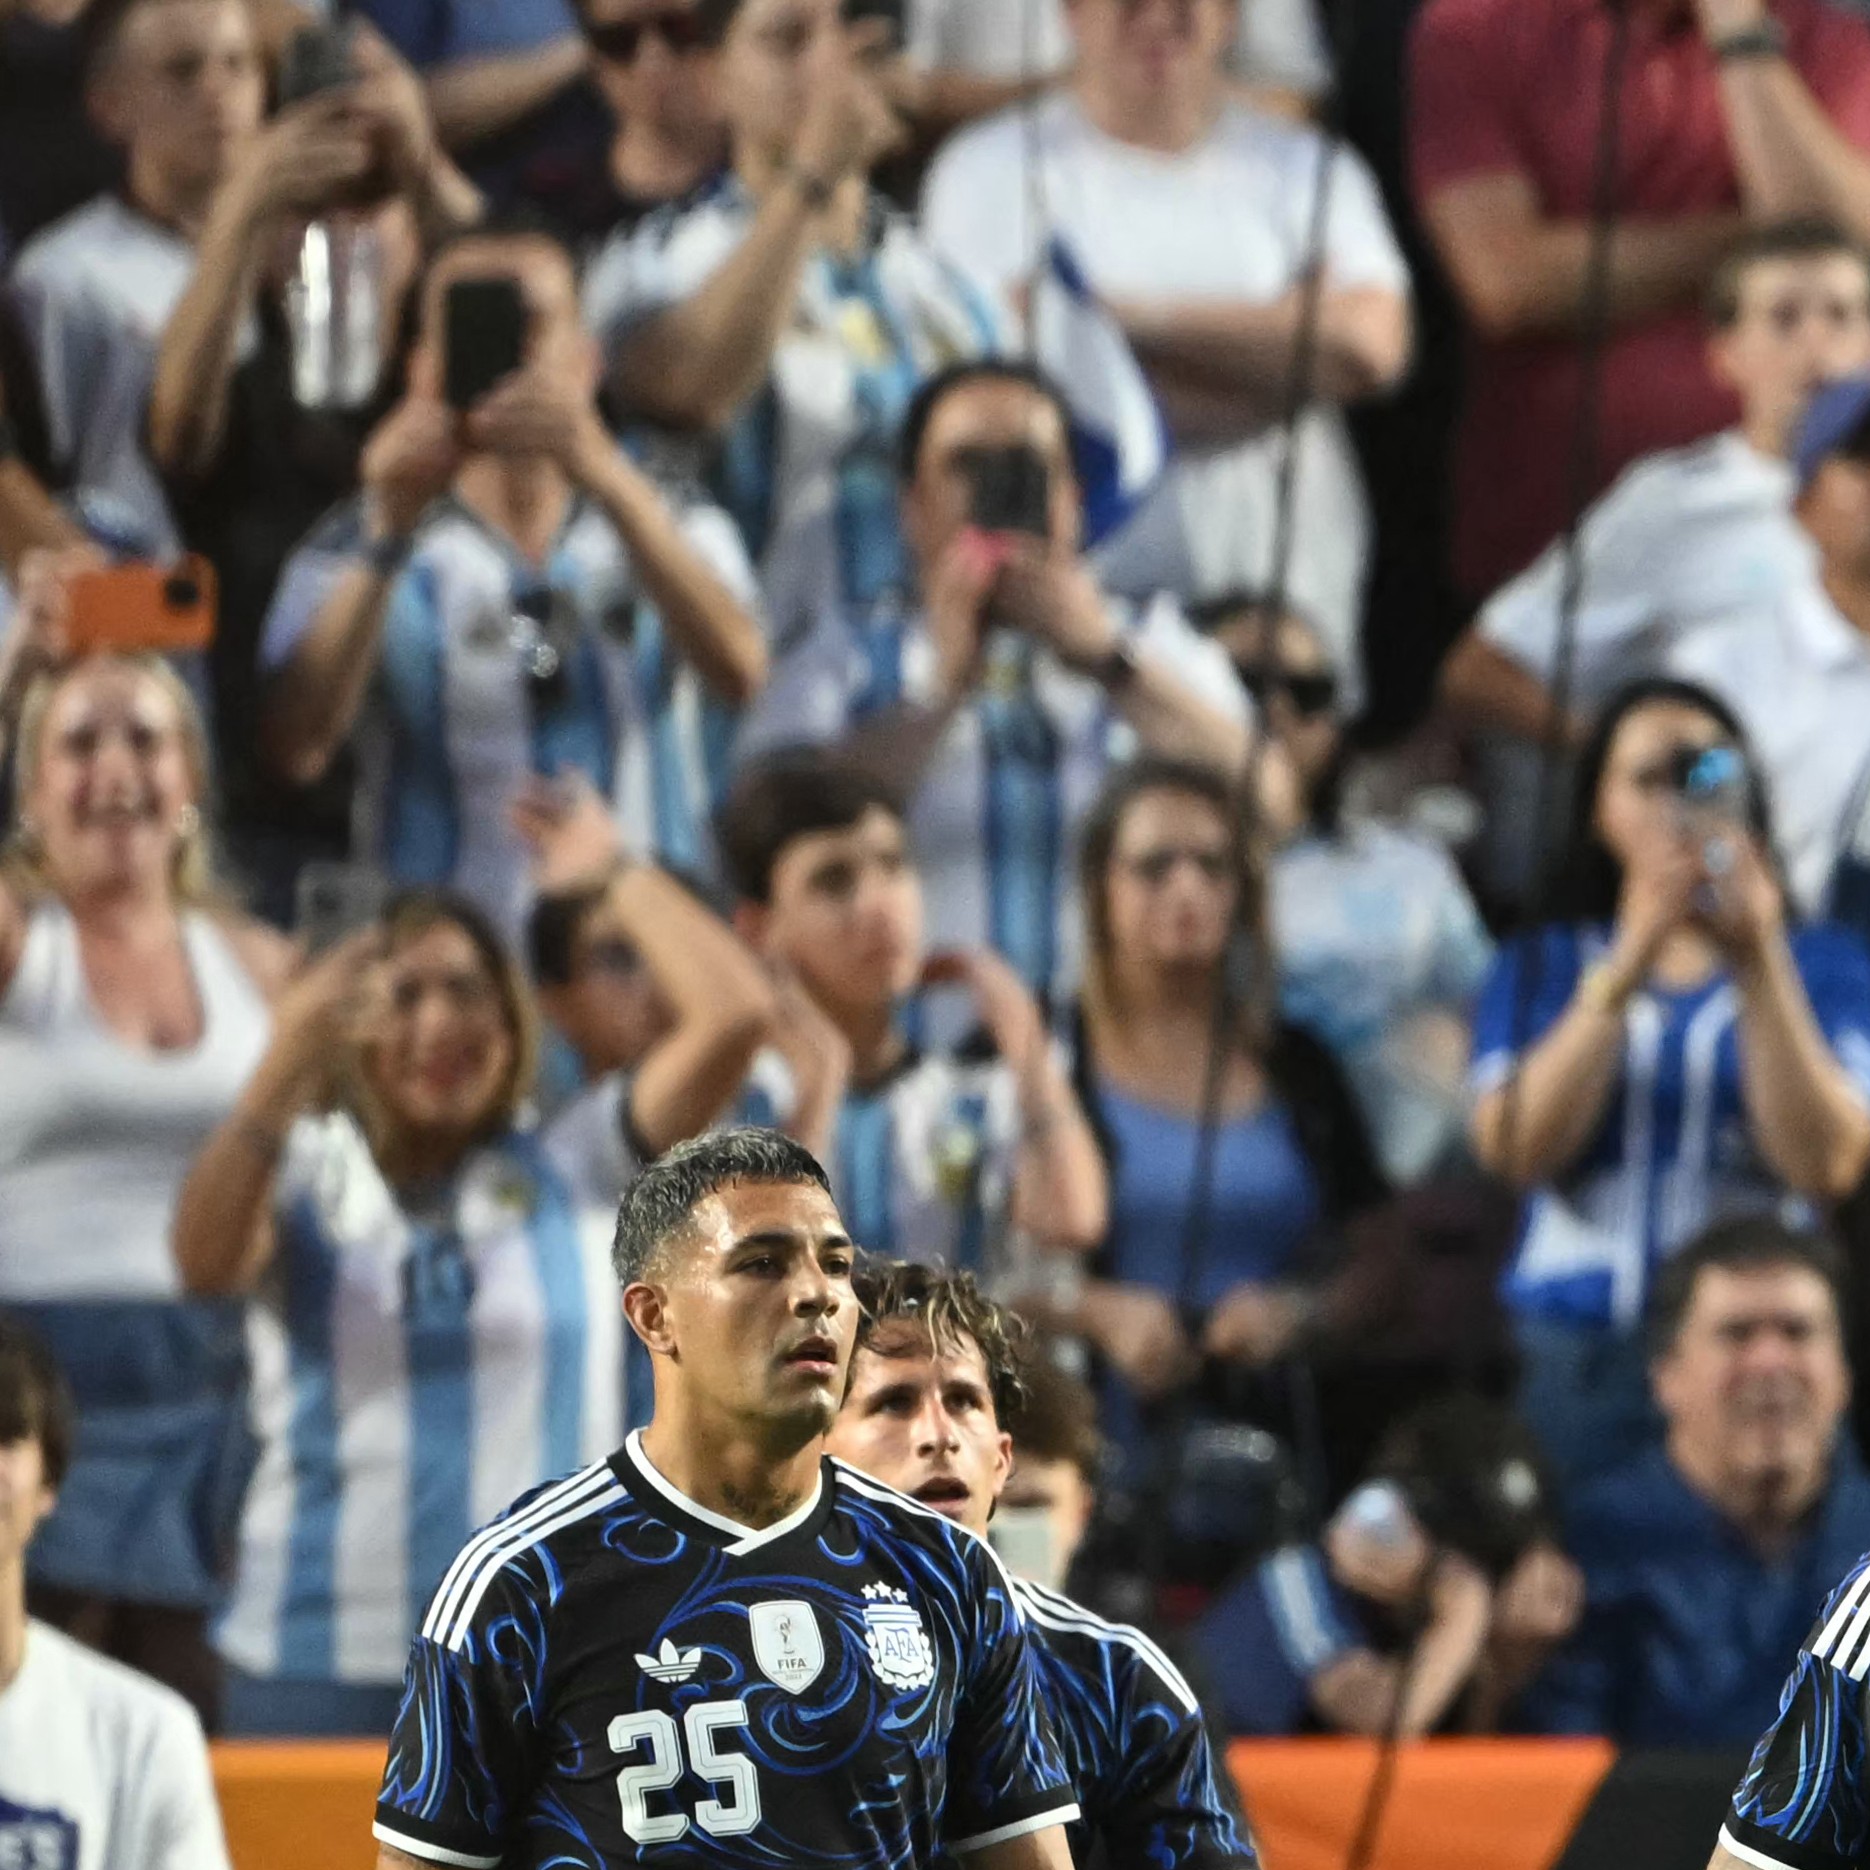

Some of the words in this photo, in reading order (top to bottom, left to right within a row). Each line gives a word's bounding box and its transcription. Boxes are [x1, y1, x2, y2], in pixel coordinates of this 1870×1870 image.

[884, 1627, 919, 1663] AFA
[778, 1658, 807, 1670] FIFA
[607, 1699, 762, 1845] 25
